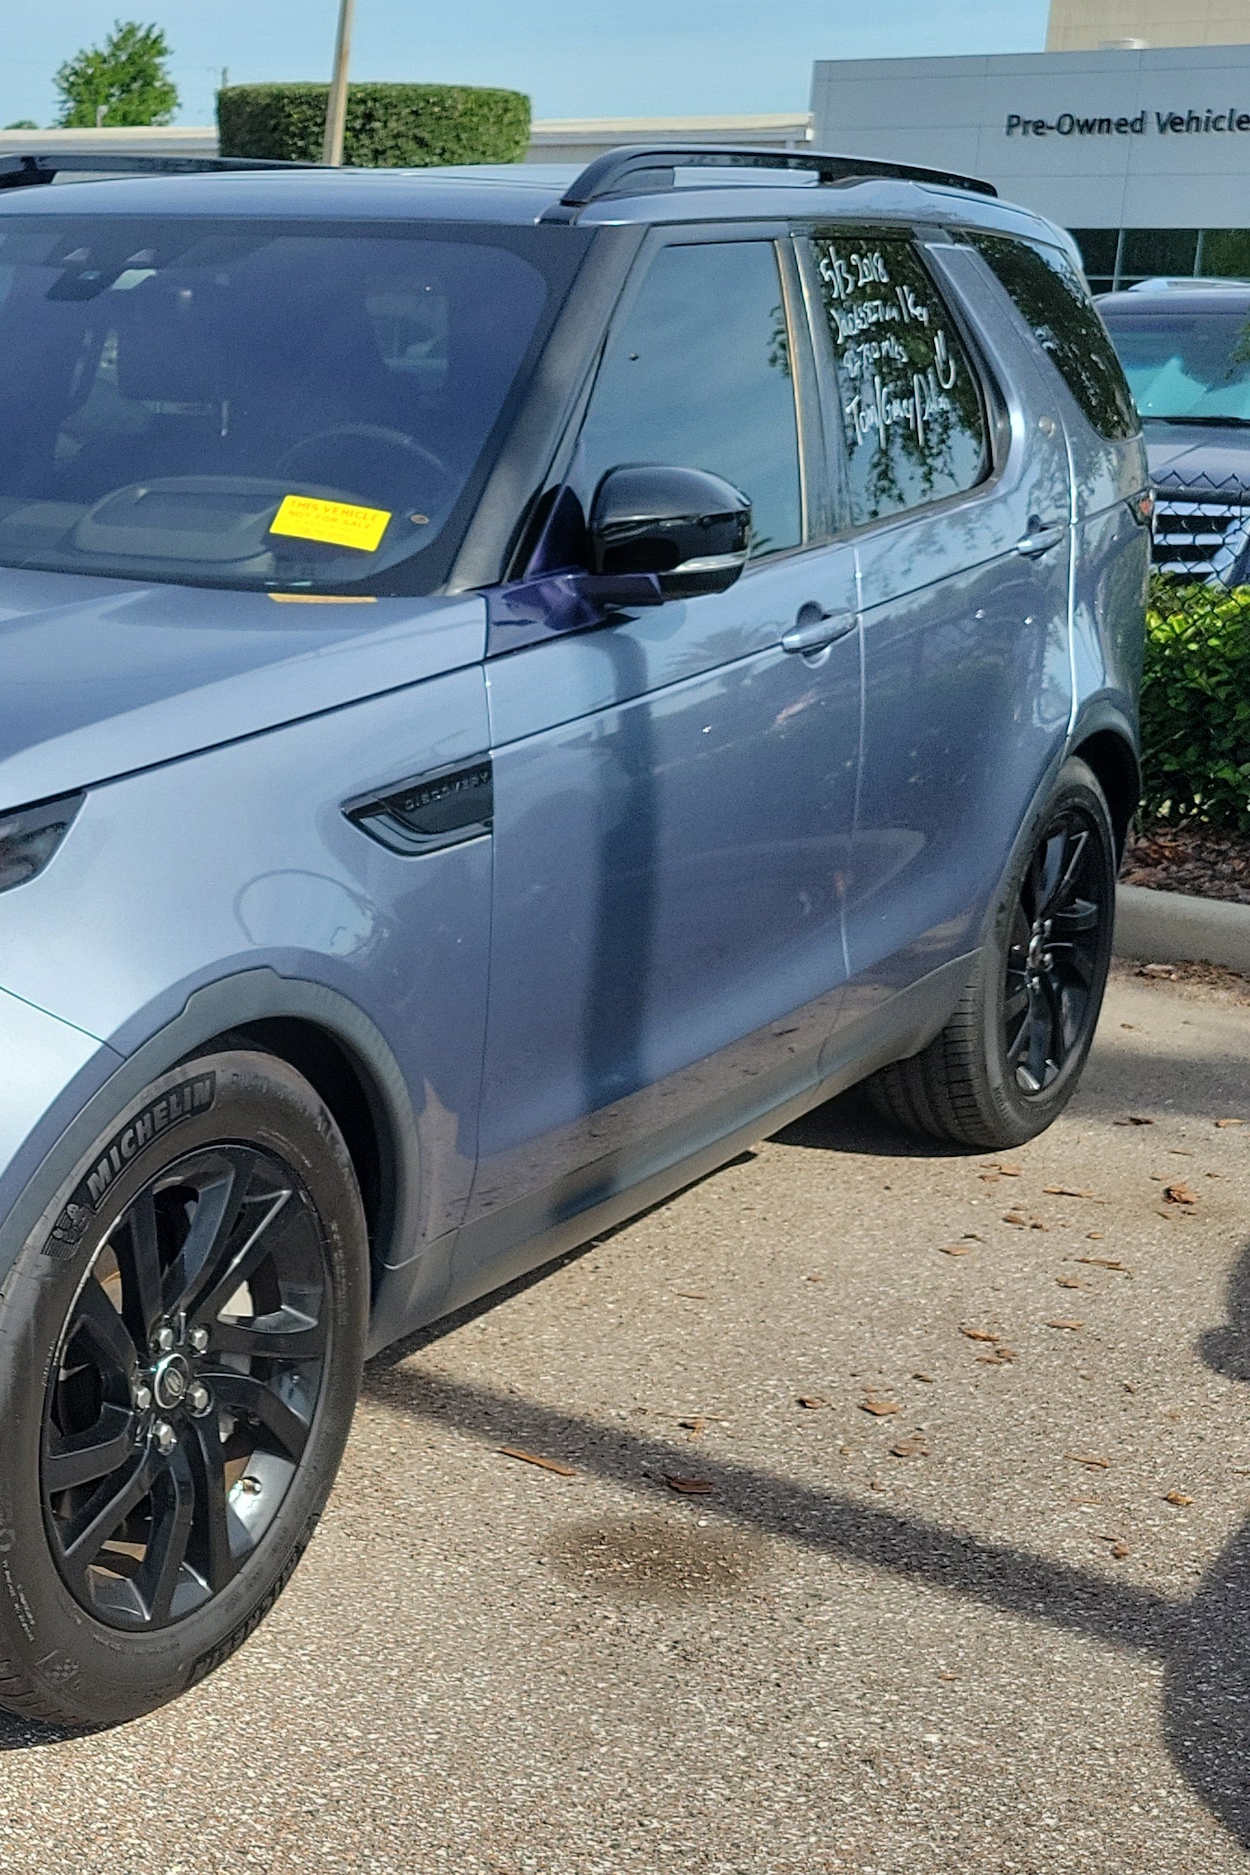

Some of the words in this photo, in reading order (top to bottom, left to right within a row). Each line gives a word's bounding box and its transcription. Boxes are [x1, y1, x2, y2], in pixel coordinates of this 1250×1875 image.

[1005, 110, 1147, 136] Pre-Owned
[288, 509, 311, 520] NOT
[315, 514, 339, 524] FOR
[342, 519, 372, 530] SALE
[290, 499, 318, 513] THIS
[324, 504, 379, 521] VEHICLE
[87, 1079, 213, 1201] MICHELIN
